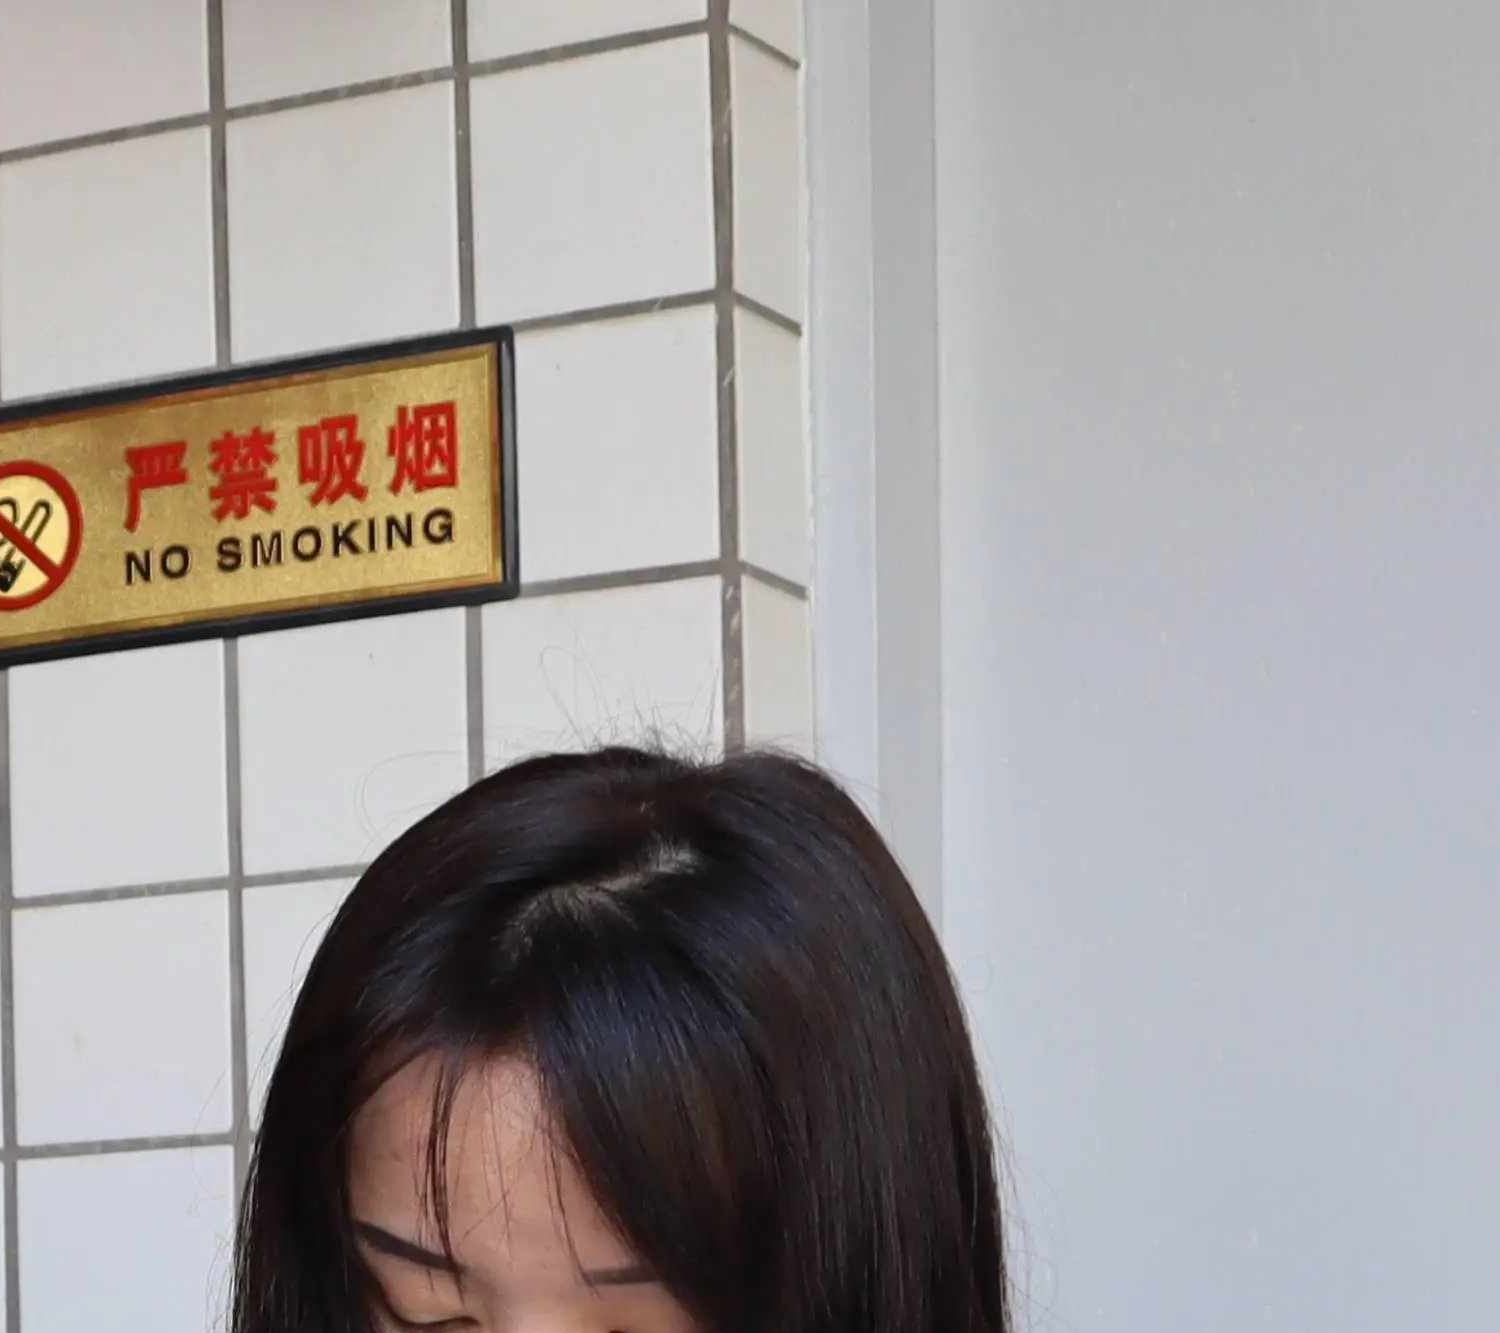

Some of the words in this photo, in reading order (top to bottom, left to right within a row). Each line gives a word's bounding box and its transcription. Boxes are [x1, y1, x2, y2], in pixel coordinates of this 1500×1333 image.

[122, 401, 460, 533] 严禁吸烟
[123, 543, 192, 586] NO
[215, 507, 456, 575] SMOKING
